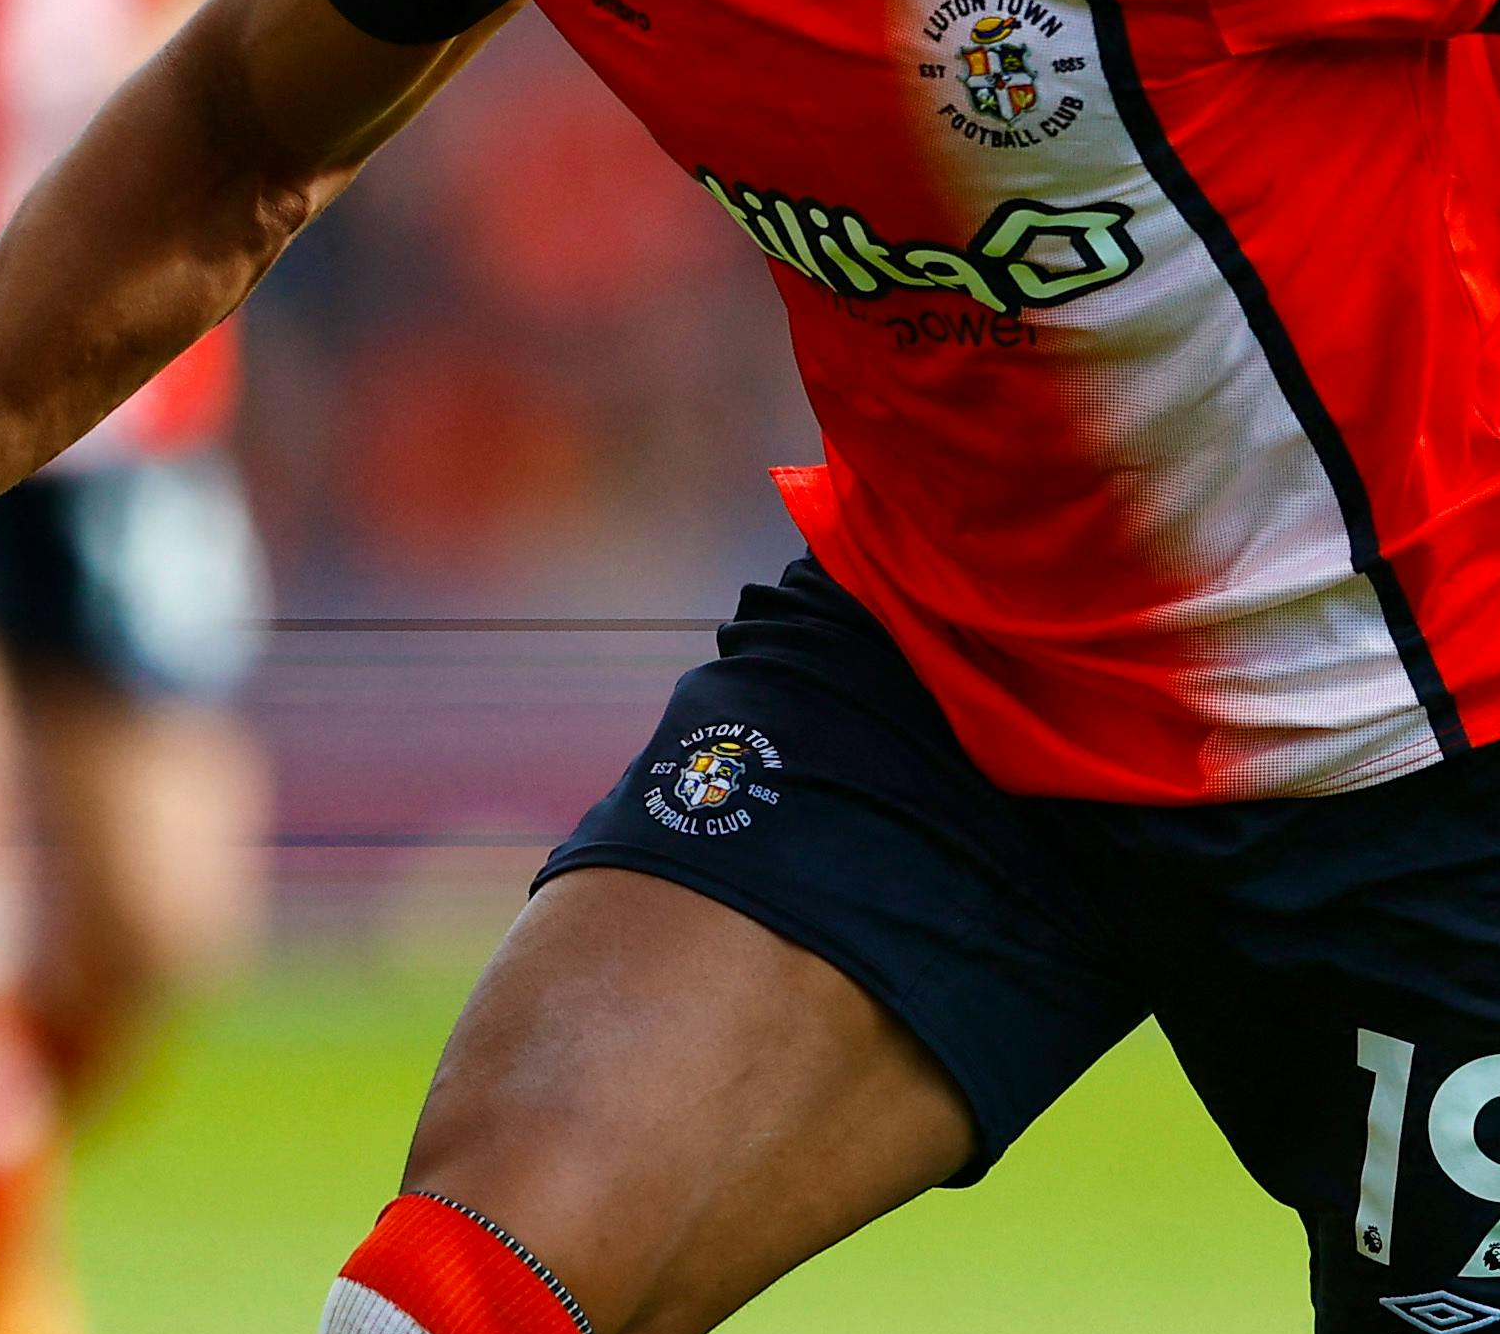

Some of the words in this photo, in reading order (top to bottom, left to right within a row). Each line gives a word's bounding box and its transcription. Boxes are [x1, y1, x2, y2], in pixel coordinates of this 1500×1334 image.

[918, 63, 946, 78] EST
[937, 103, 1042, 148] FOOTBALL
[1040, 96, 1084, 138] CLUB
[680, 723, 745, 748] LUTON
[745, 729, 783, 770] TOWN
[650, 762, 677, 775] EST
[643, 786, 699, 835] FOOTBALL
[706, 808, 752, 836] CLUB
[748, 783, 781, 806] 1885
